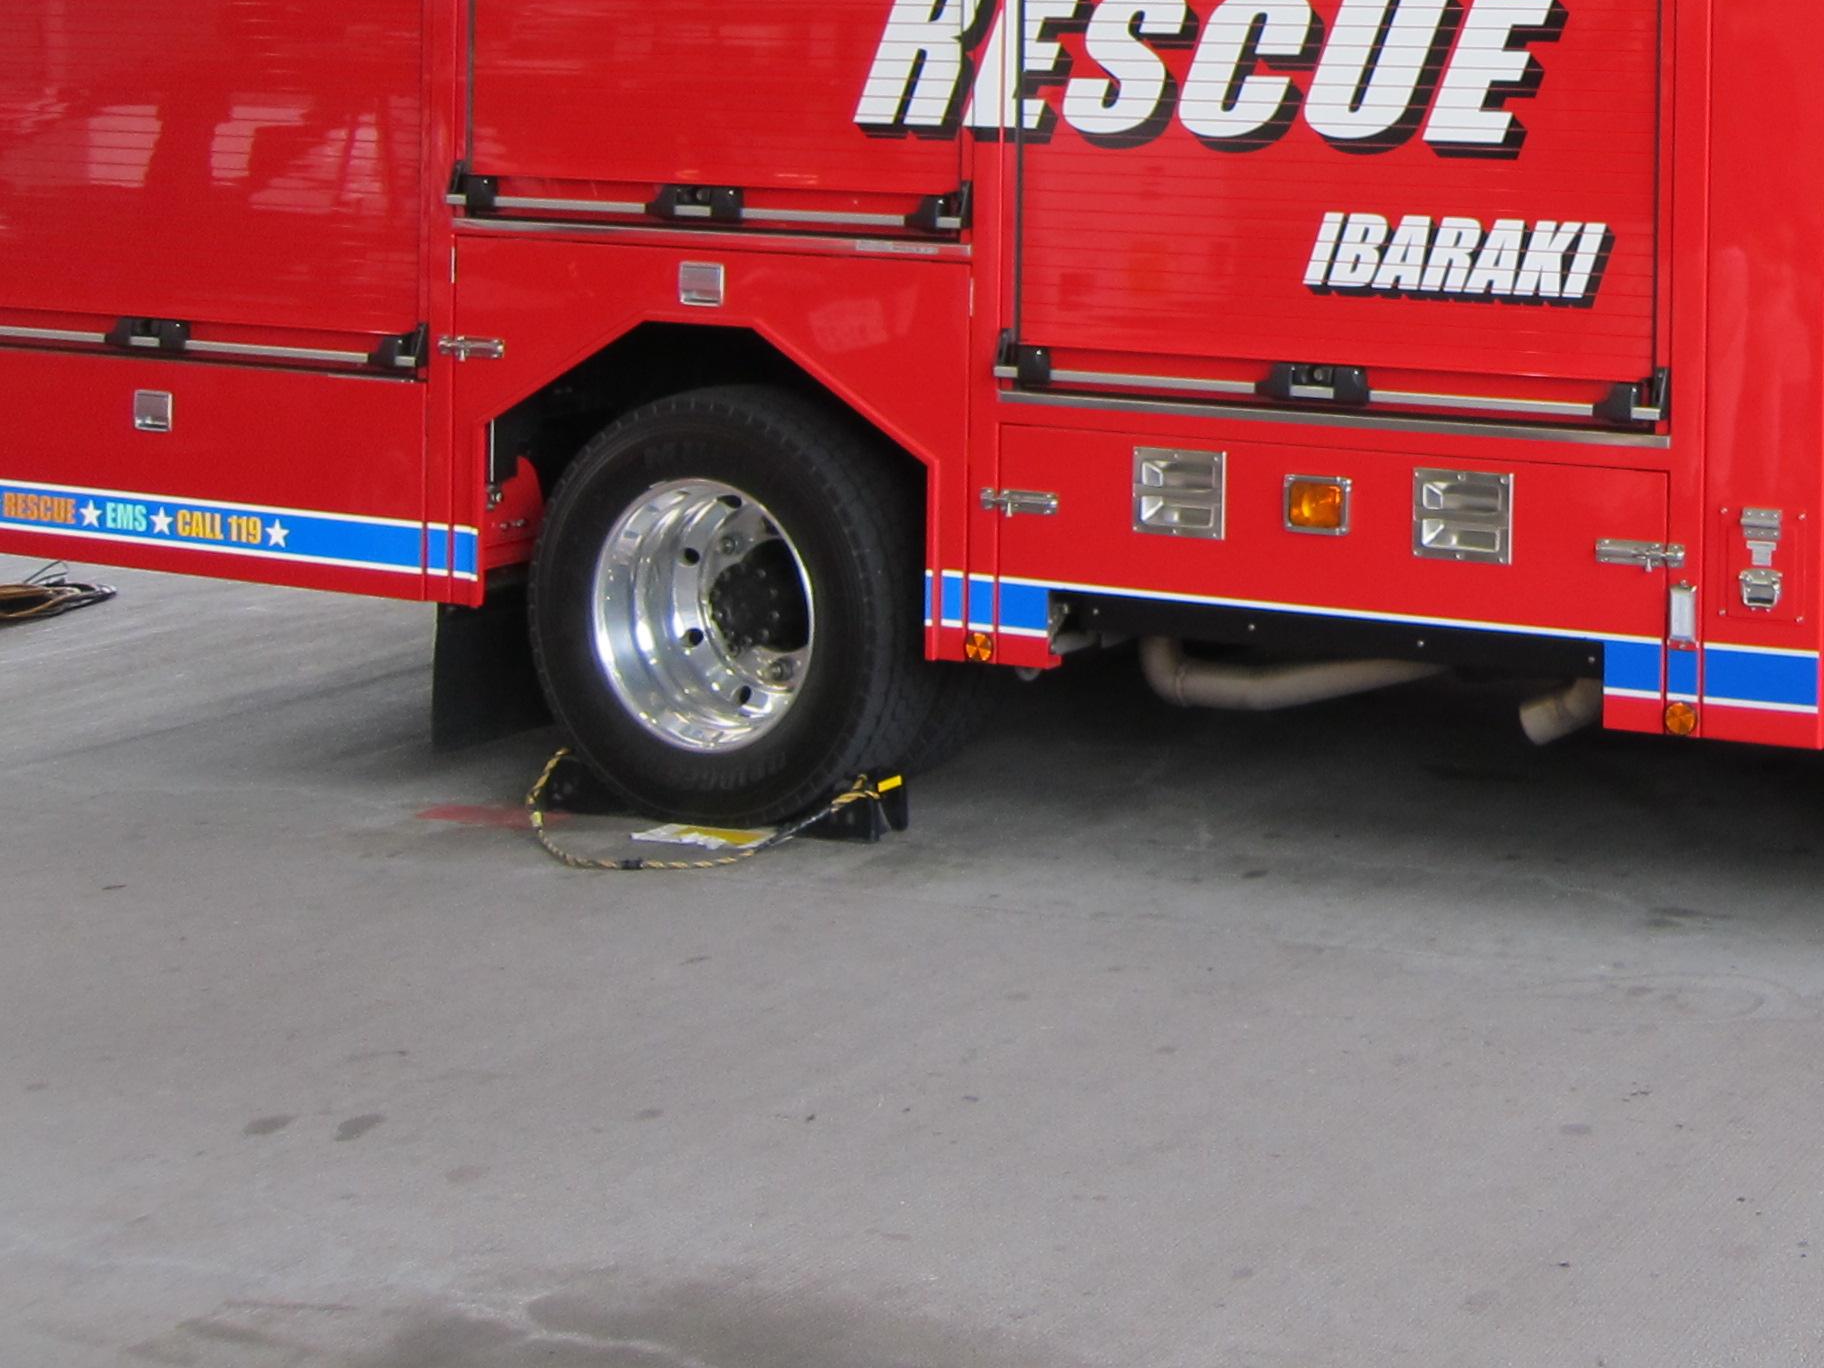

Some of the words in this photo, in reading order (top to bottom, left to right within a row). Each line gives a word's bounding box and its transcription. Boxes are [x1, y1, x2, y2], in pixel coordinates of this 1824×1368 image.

[1302, 212, 1611, 303] IBARAKI
[2, 492, 77, 525] RESCUE
[105, 501, 148, 532] EMS
[176, 508, 224, 541] CALL
[228, 515, 263, 545] 119
